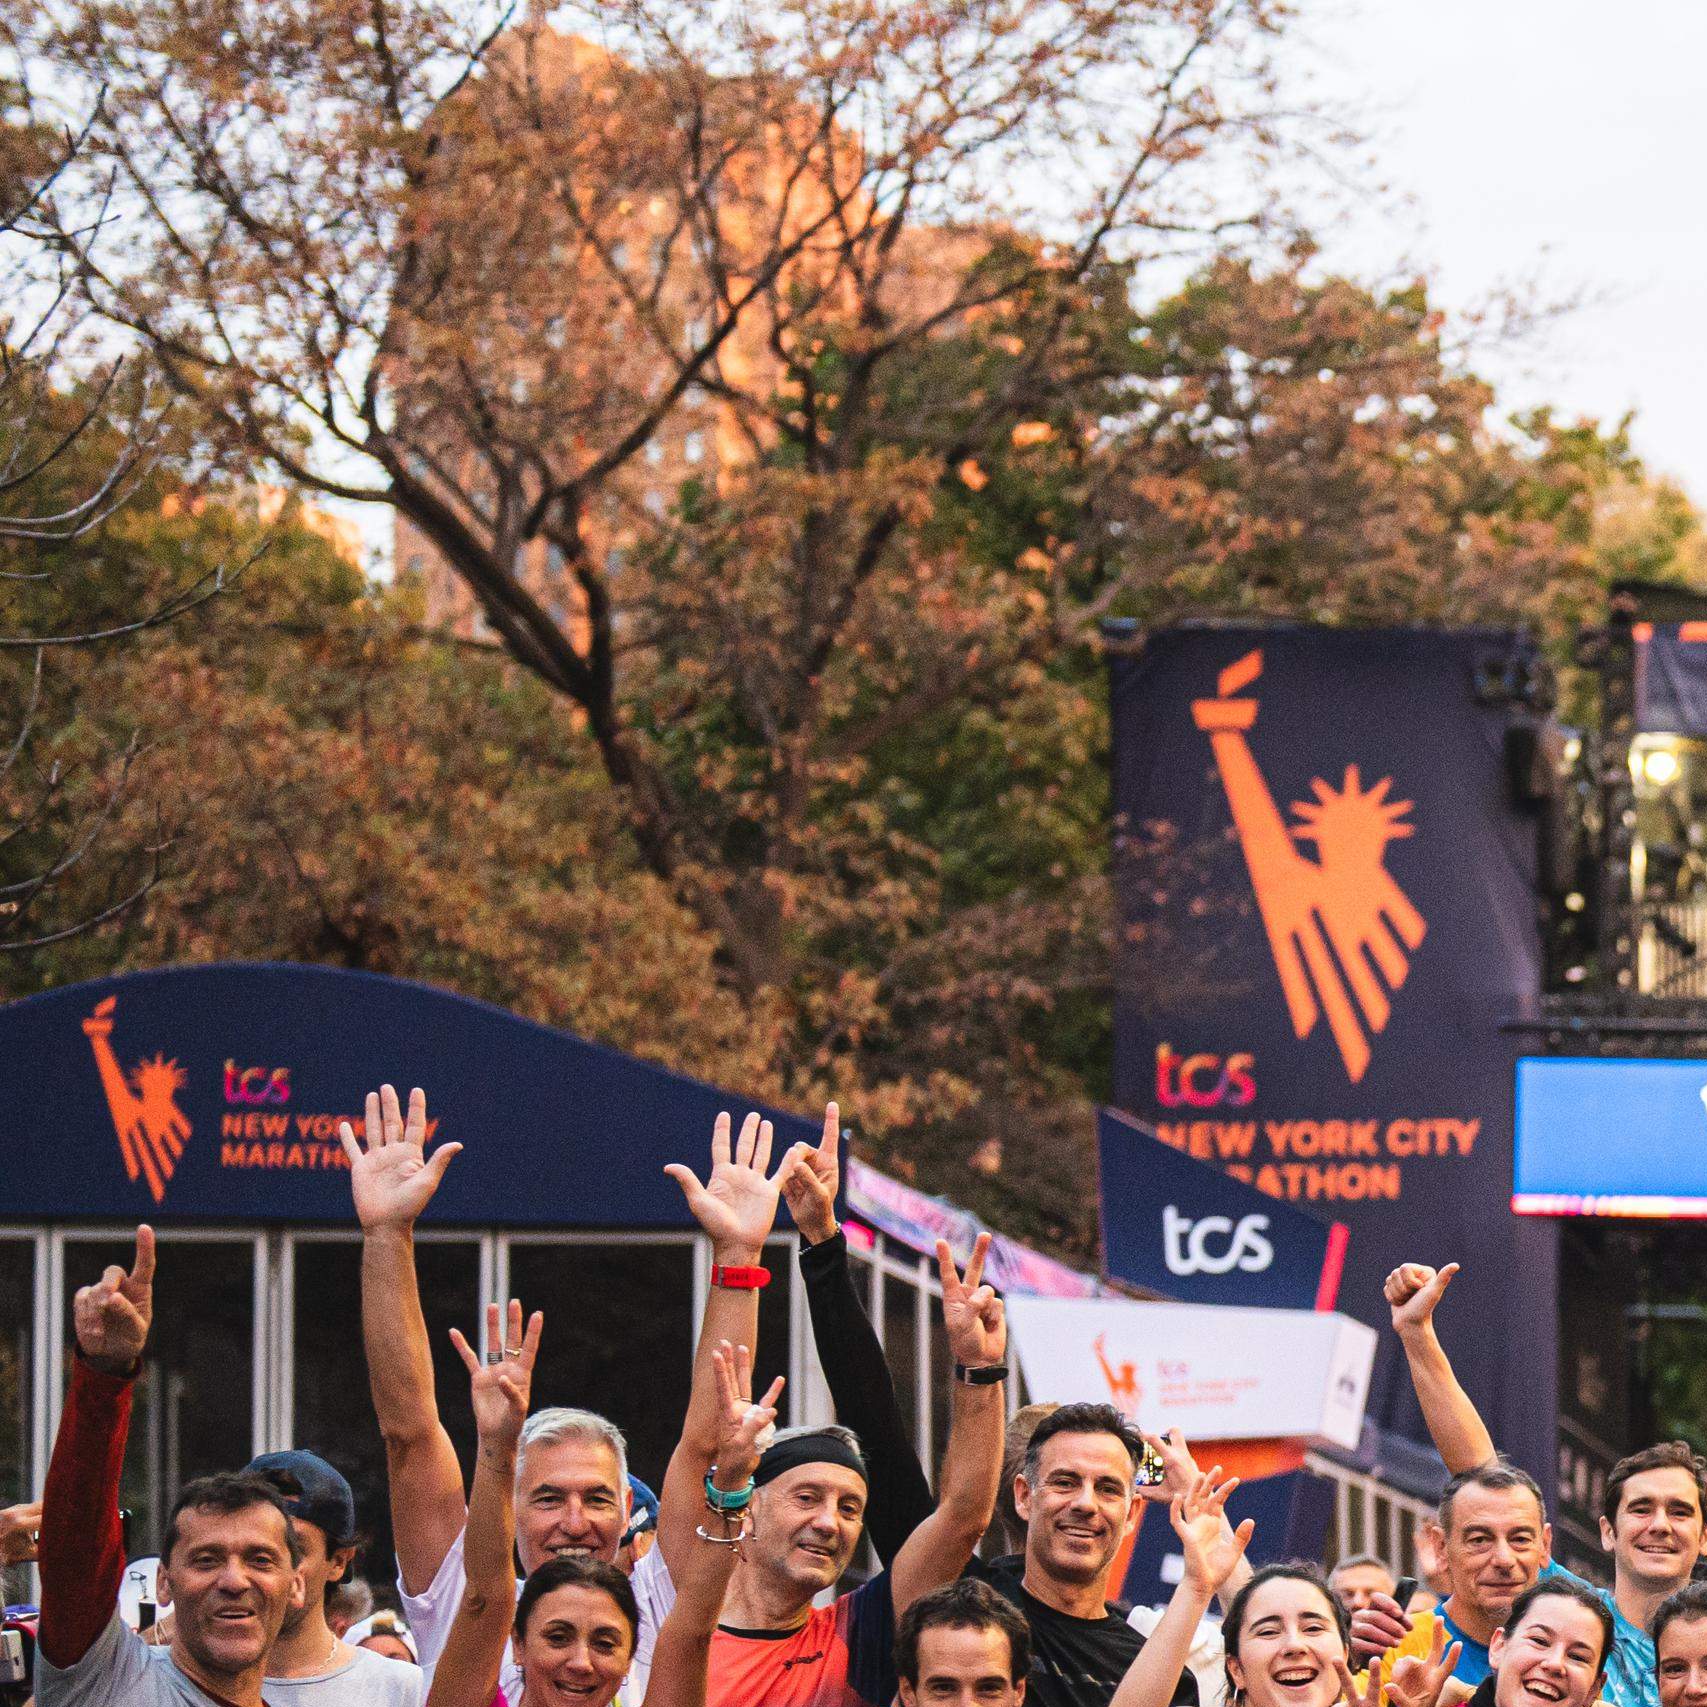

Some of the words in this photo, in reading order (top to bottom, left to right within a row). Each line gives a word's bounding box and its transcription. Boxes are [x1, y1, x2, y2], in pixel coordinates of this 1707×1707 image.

[224, 1058, 291, 1104] tcs
[1156, 1043, 1256, 1108] tcs
[222, 1113, 290, 1139] NEW
[1155, 1120, 1257, 1160] NEW
[1264, 1119, 1379, 1158] YORK
[1385, 1118, 1481, 1157] CITY
[222, 1143, 352, 1168] MARATH
[1163, 1204, 1274, 1276] tcs
